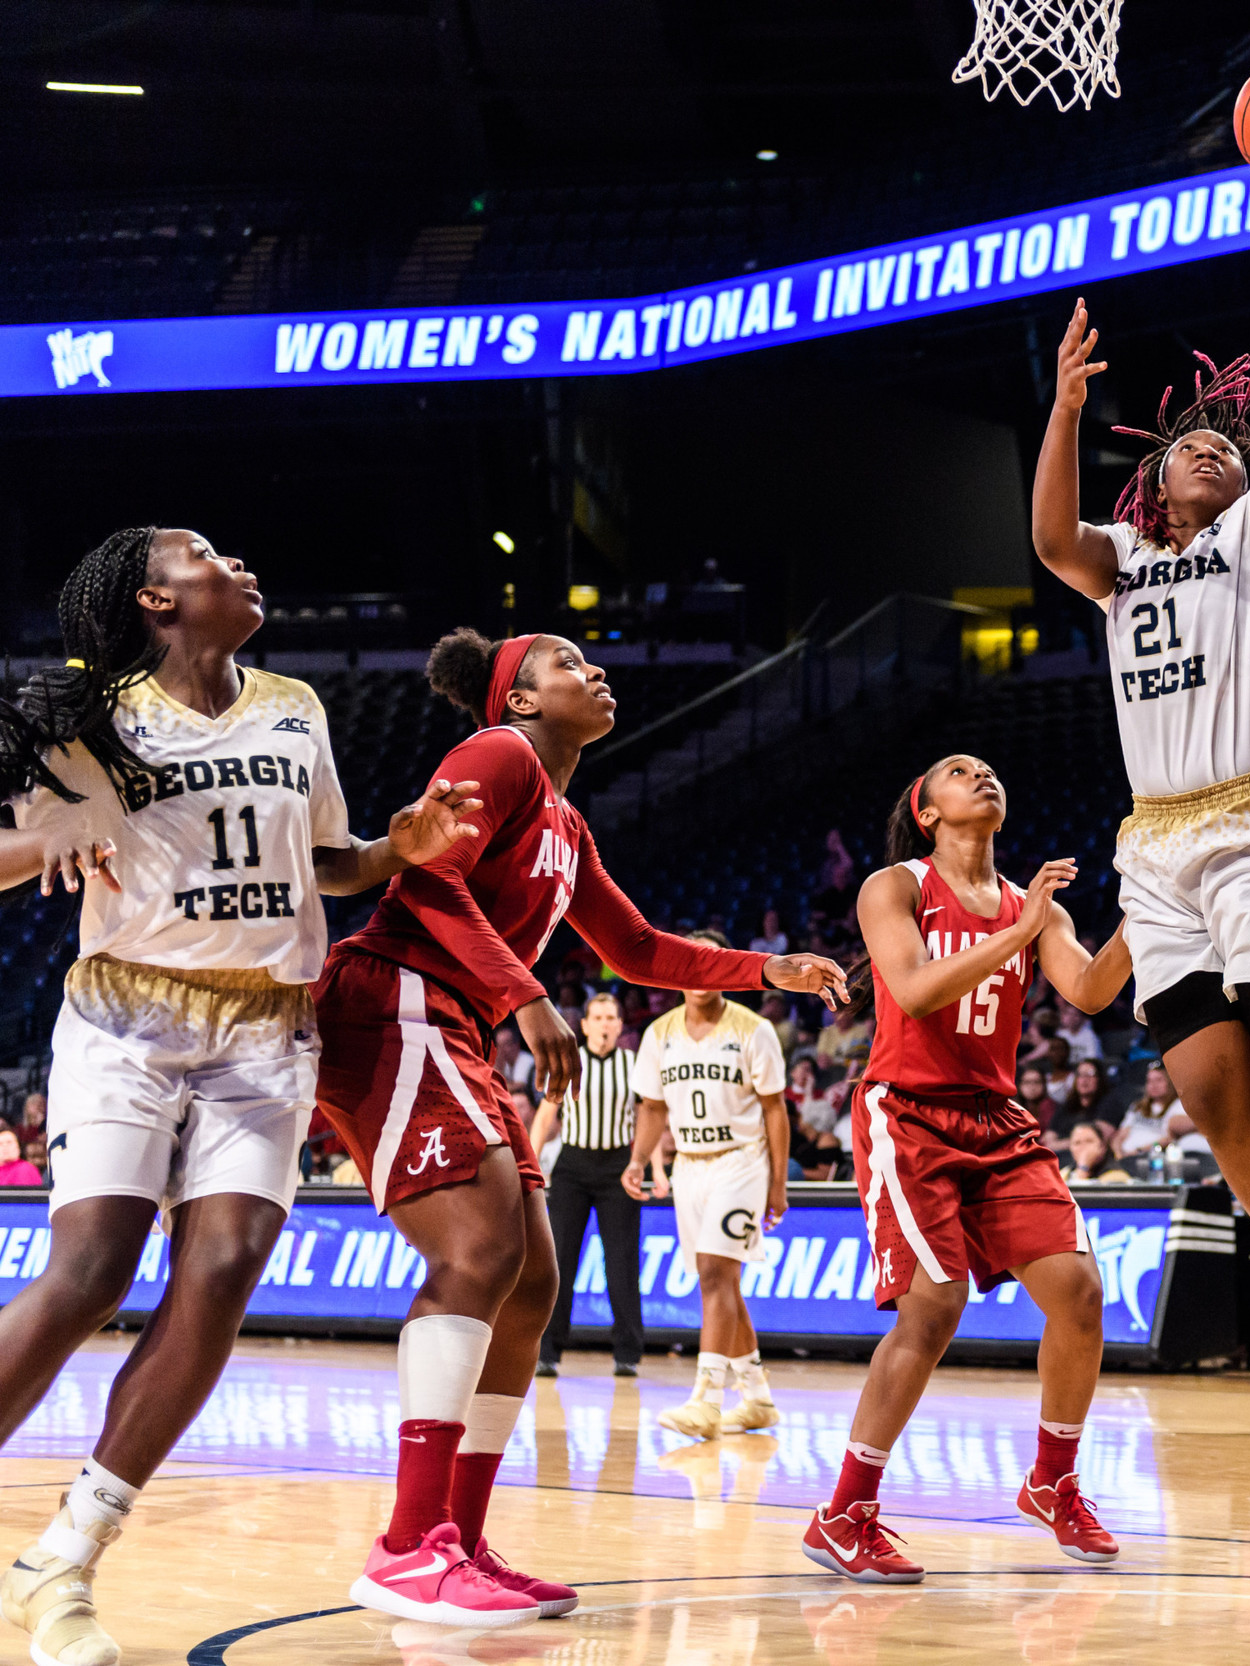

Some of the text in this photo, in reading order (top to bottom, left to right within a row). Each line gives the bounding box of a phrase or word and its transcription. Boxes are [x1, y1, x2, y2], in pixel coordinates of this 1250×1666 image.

[275, 314, 539, 373] WOMEN'S
[560, 277, 797, 363] NATIONAL
[812, 214, 1090, 323] INVITATION
[1114, 548, 1231, 597] EORGIA
[1131, 597, 1182, 658] 21
[1121, 654, 1207, 703] TECH
[272, 717, 311, 735] ACC
[124, 754, 311, 812] GEORGIA
[208, 805, 261, 870] 11
[174, 882, 295, 921] TECH
[955, 974, 1005, 1036] 15
[660, 1063, 744, 1087] GEORGIA
[692, 1090, 706, 1119] 0
[407, 1126, 450, 1175] A
[679, 1125, 734, 1143] TECH
